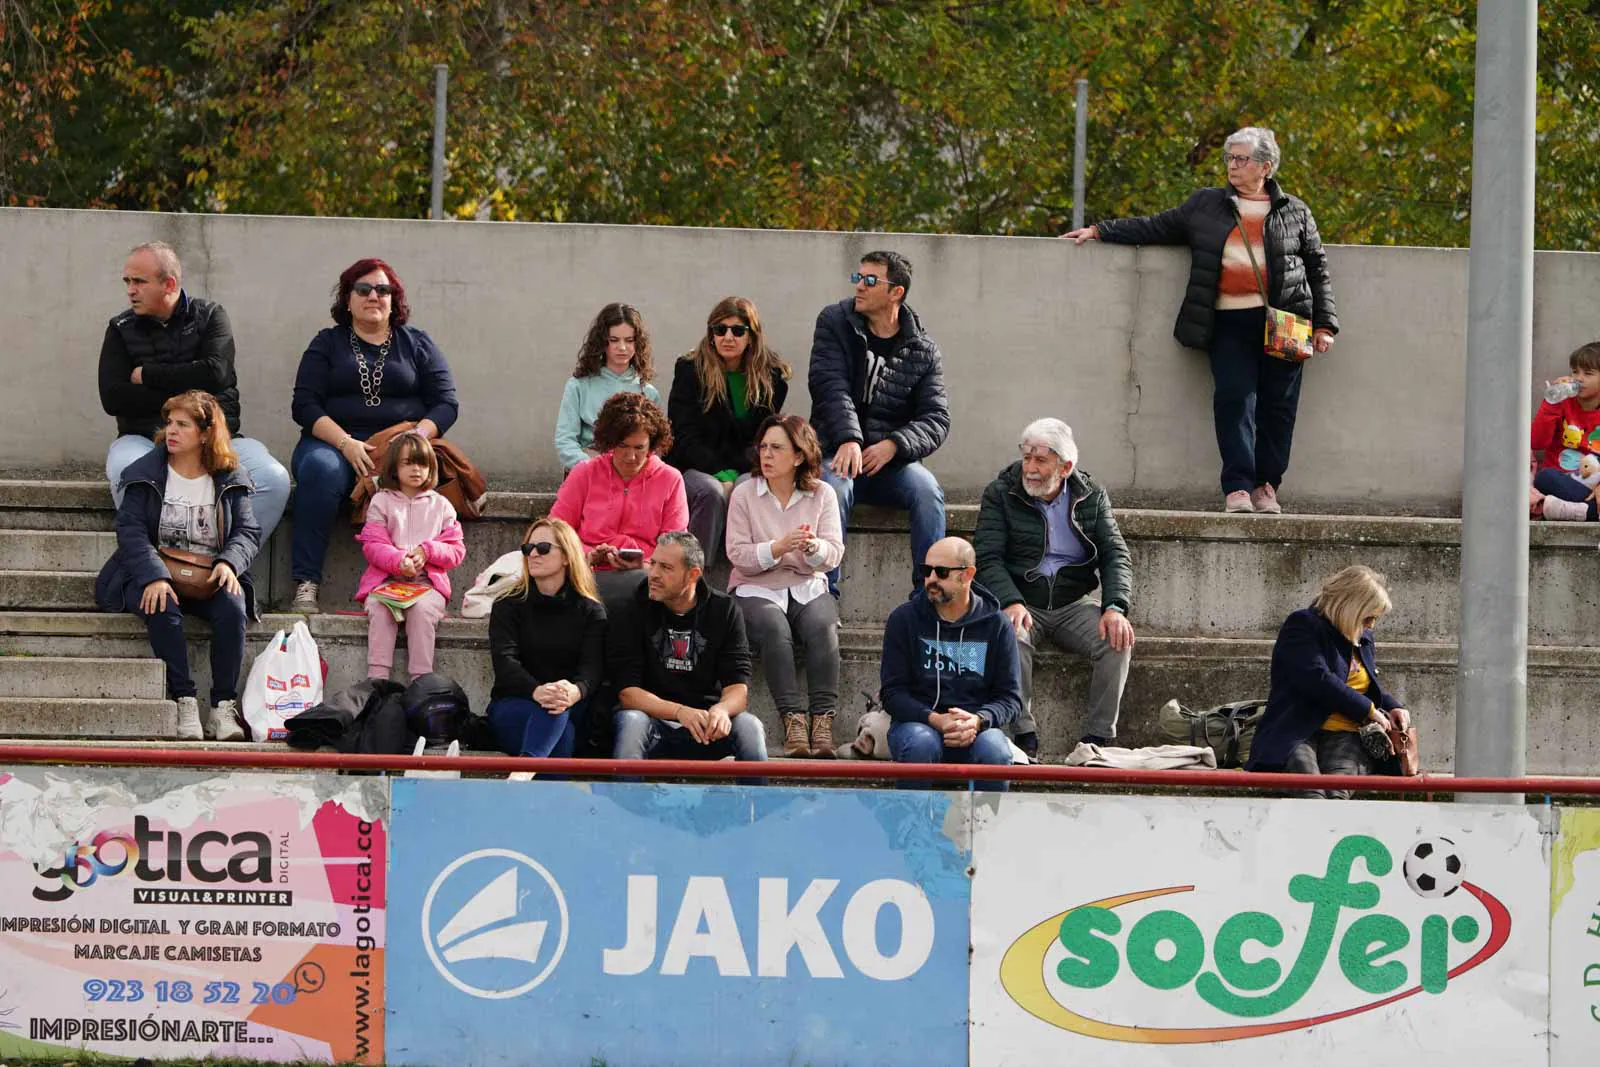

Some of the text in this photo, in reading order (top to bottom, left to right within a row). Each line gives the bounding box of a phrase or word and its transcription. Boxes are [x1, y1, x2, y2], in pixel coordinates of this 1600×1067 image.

[925, 645, 977, 657] JACK &
[923, 659, 977, 673] JONES
[279, 831, 290, 884] DIGITAL
[138, 890, 288, 904] VISUAL&PRINTER
[0, 914, 341, 938] MPRESIÓN DIGITAL Y GRAN FORMATO
[603, 874, 935, 981] JAKO
[1056, 834, 1480, 1018] socfer
[74, 944, 262, 962] MARCAJE CAMISETAS
[83, 979, 297, 1006] 923 18 52 20
[30, 1013, 274, 1044] IMPRESIÓNARTE...
